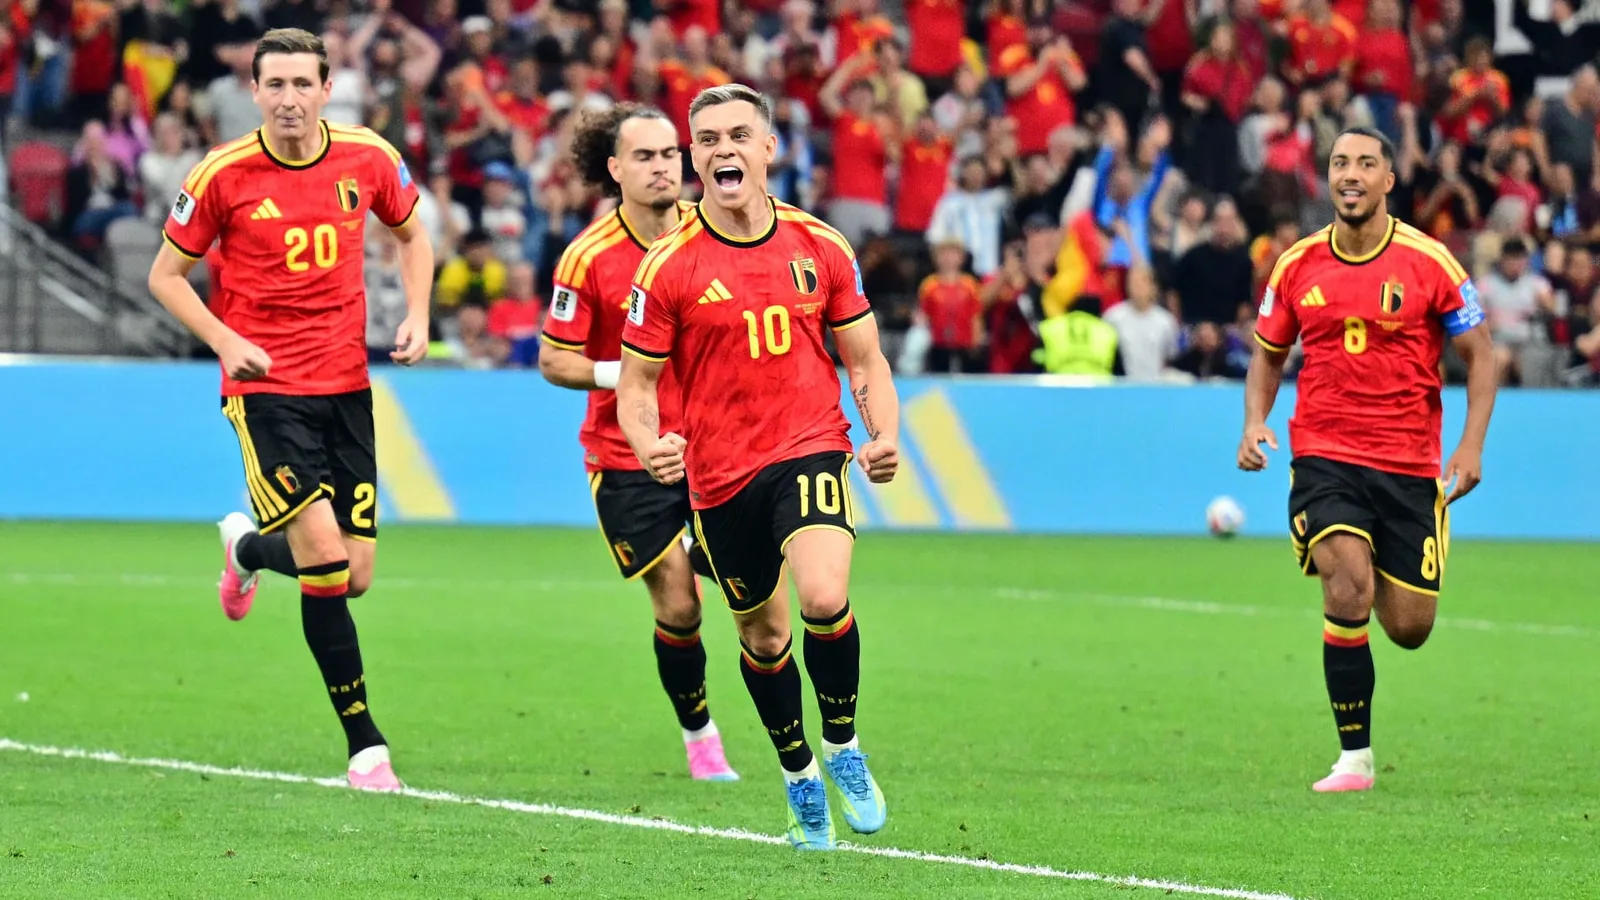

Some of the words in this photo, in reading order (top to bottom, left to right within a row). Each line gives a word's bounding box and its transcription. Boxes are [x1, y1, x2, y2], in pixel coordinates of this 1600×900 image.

[284, 224, 338, 272] 20
[742, 305, 791, 359] 10
[1344, 316, 1367, 354] 8
[351, 483, 374, 528] 2
[797, 472, 841, 517] 10
[1421, 536, 1437, 581] 8
